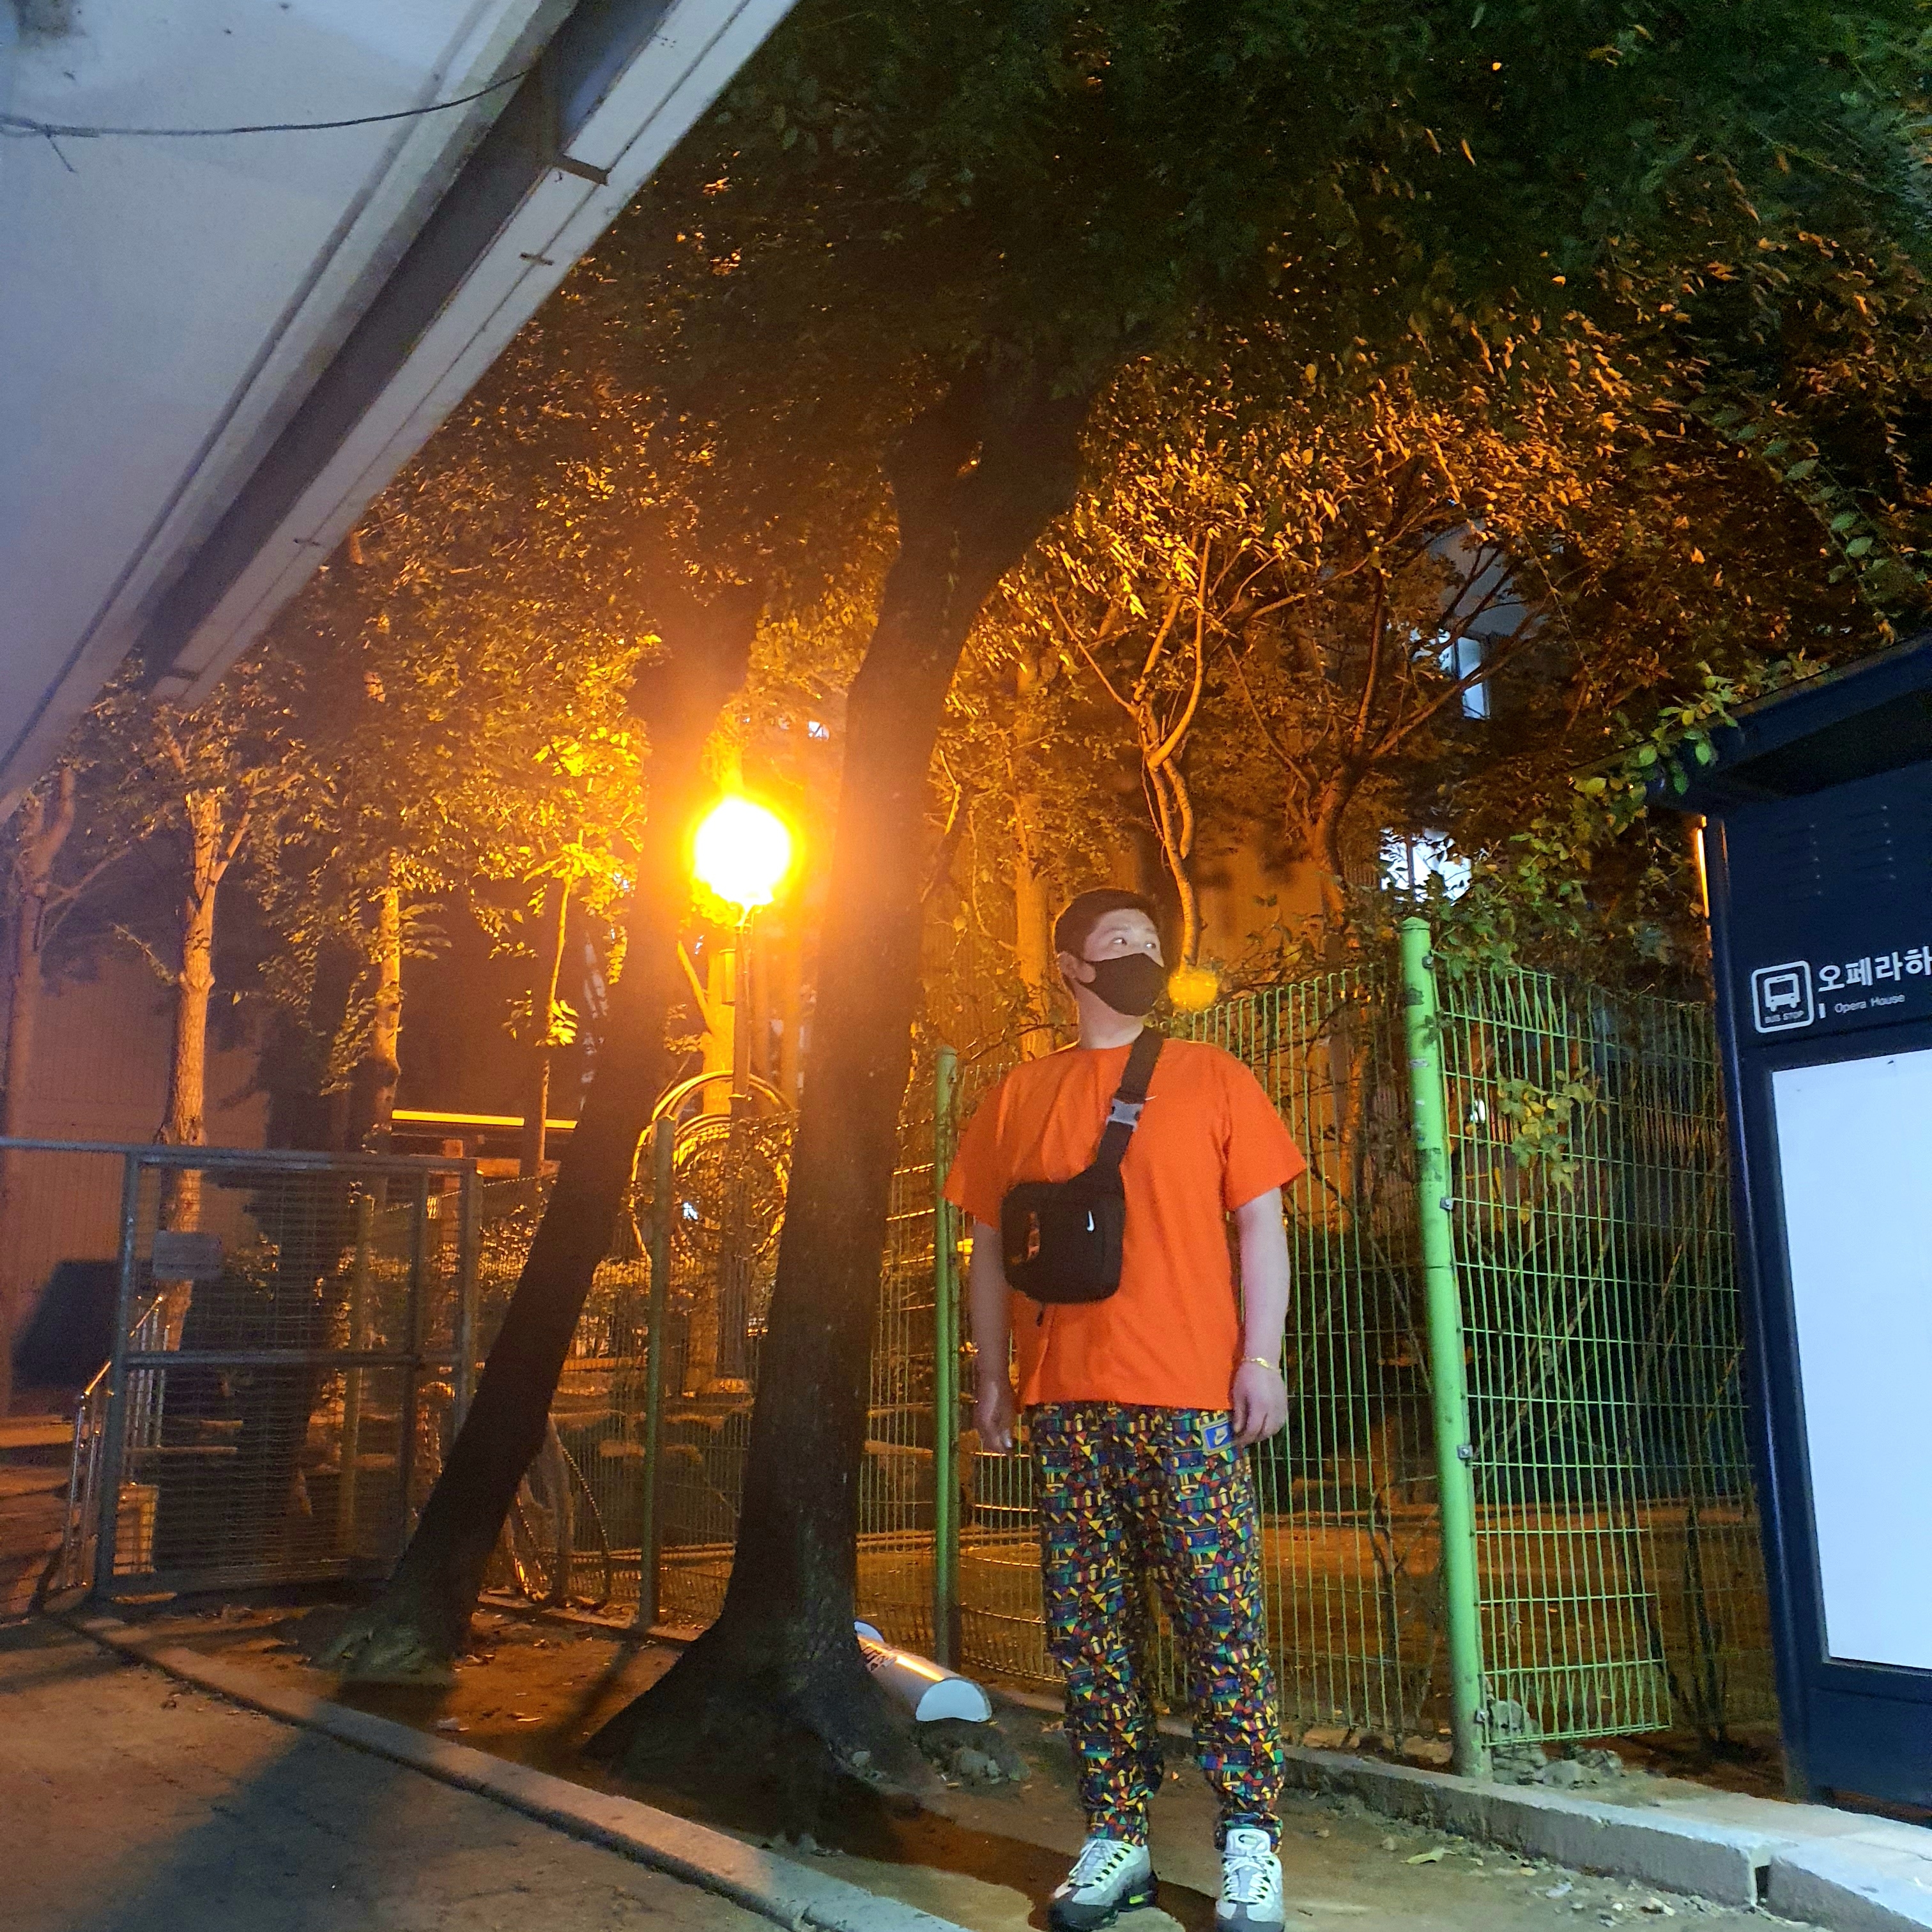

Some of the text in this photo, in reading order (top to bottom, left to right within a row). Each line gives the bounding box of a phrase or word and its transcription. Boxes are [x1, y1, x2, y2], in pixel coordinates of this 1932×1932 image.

[1818, 946, 1932, 992] 오페라하
[1834, 994, 1905, 1013] Opera House
